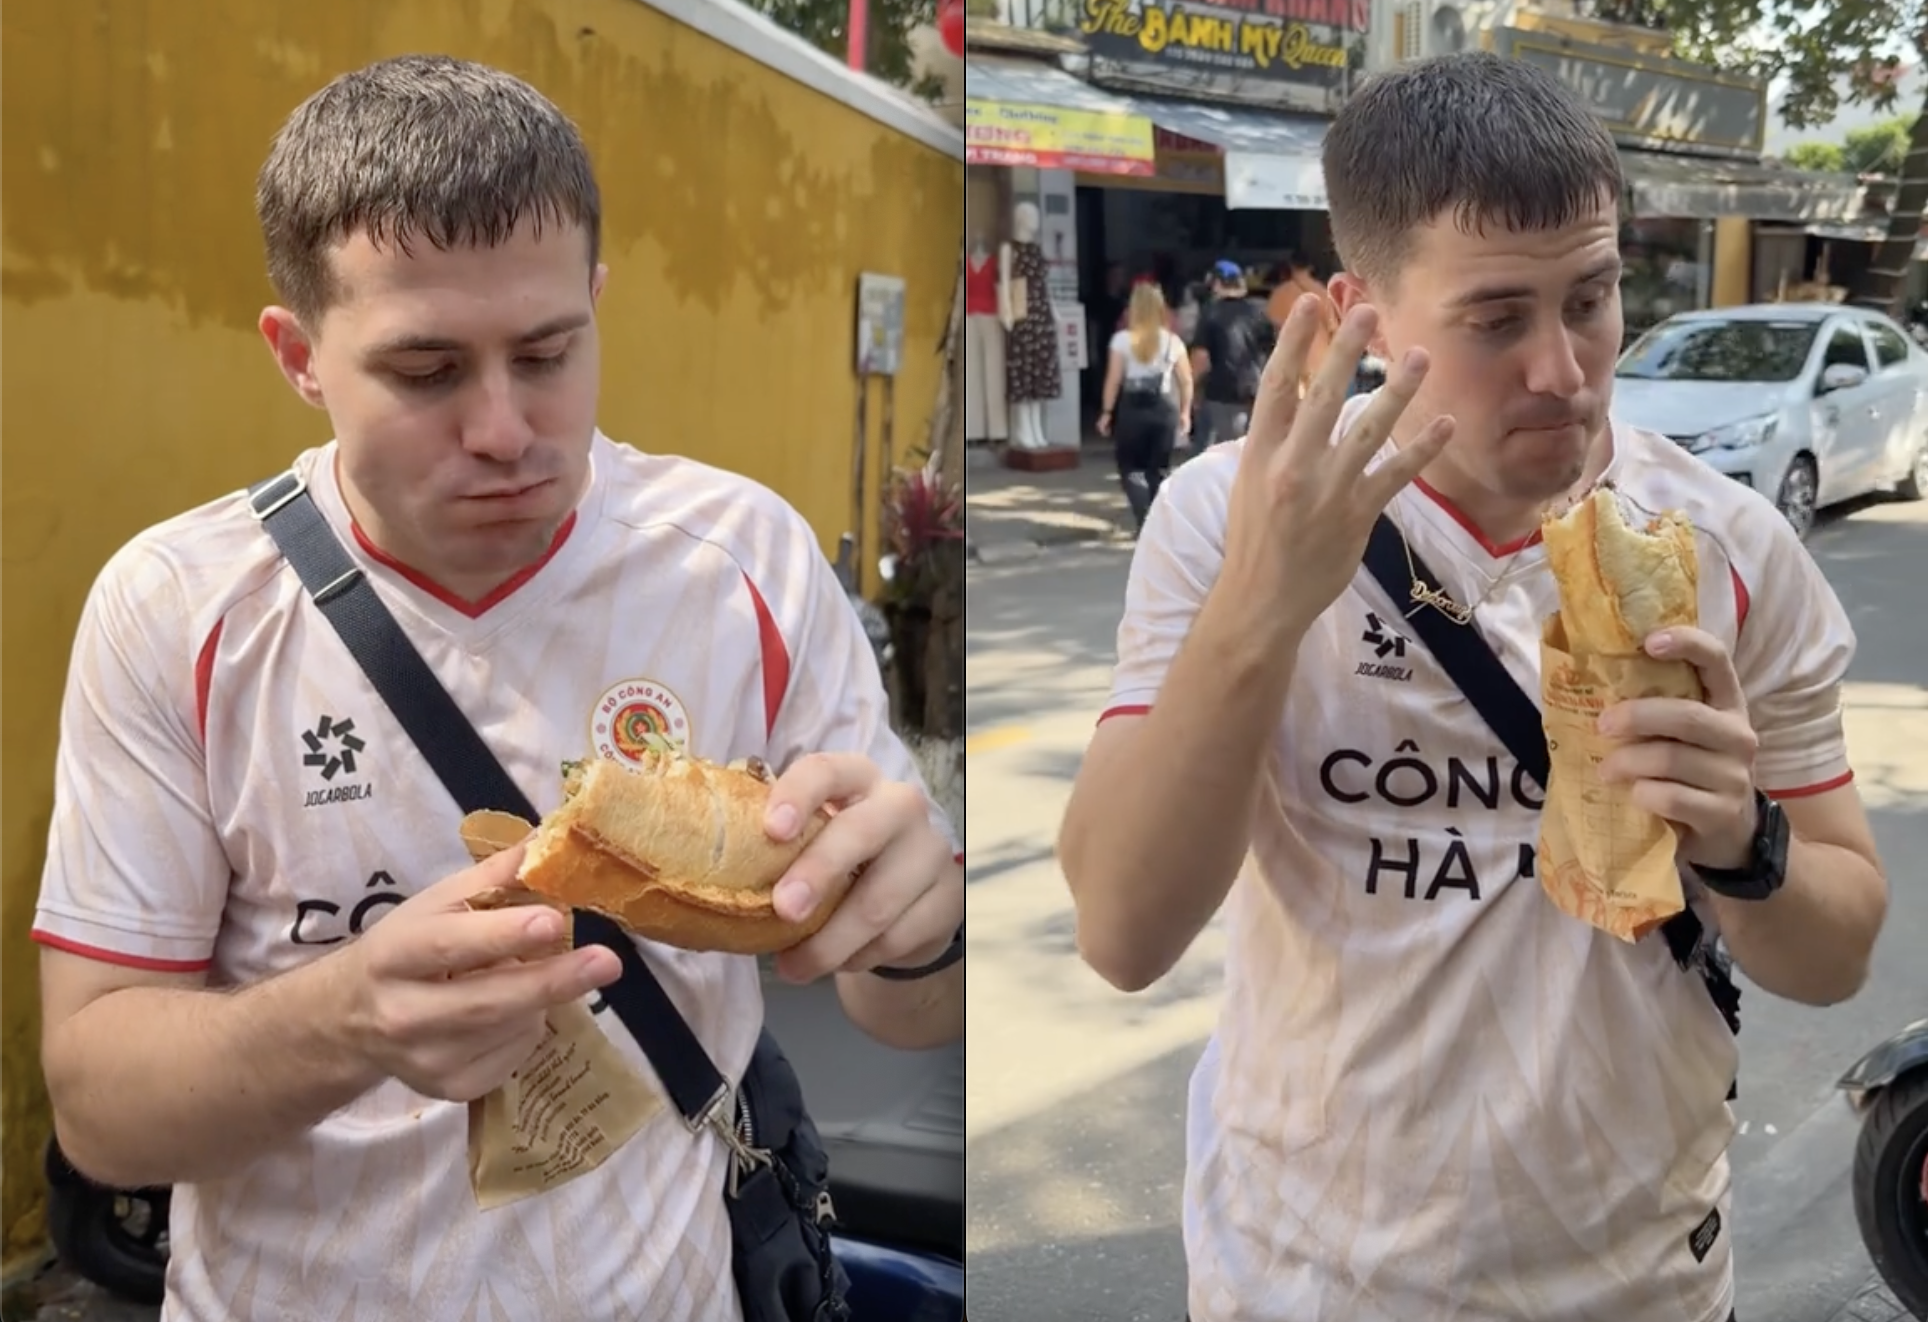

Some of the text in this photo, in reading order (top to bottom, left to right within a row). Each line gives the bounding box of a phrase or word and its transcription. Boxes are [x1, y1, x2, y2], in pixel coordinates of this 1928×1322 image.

[1081, 0, 1140, 36] The
[1281, 21, 1347, 69] Queen
[1365, 826, 1481, 901] HÀ
